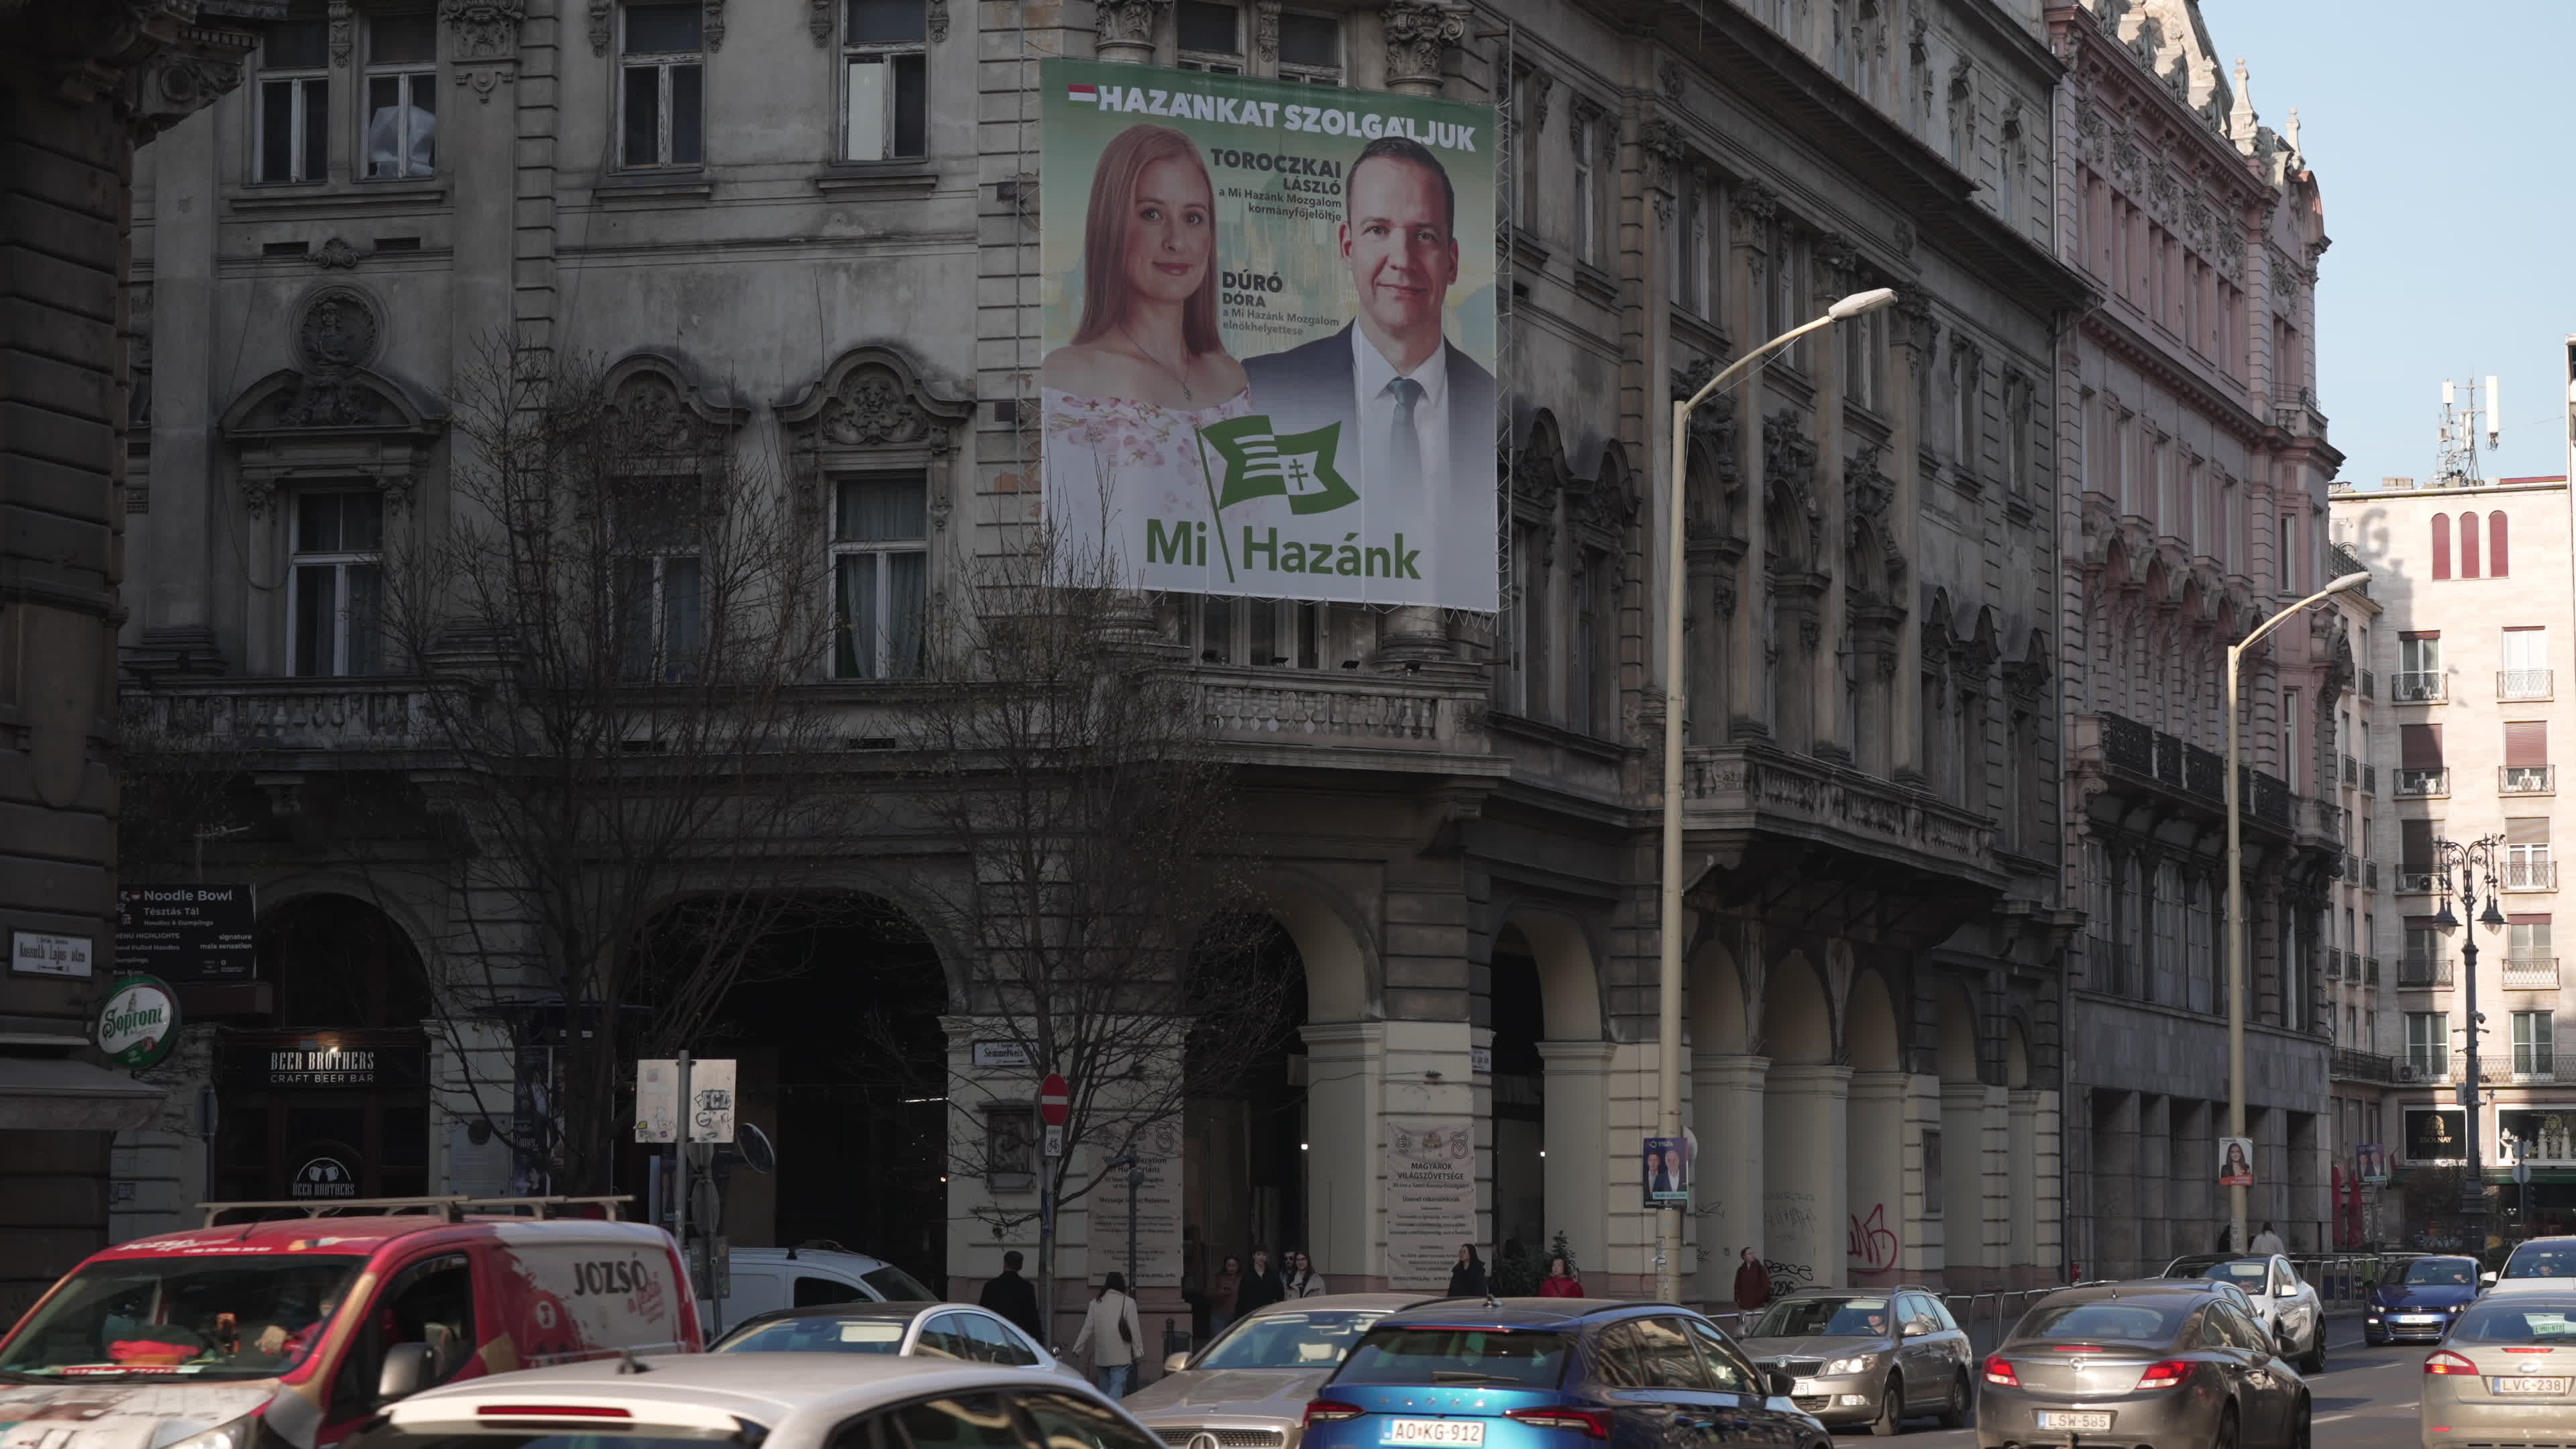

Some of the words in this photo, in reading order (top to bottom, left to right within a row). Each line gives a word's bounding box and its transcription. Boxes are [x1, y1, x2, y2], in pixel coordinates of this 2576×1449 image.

[1098, 85, 1279, 128] HAZÁNKAT
[1283, 104, 1477, 152] SZOLGÁLJUK
[1211, 148, 1341, 178] TOROCZKAI
[1283, 176, 1341, 195] LÁSZLÓ
[1228, 187, 1242, 198] Mi
[1244, 190, 1283, 203] Hazánk
[1287, 193, 1341, 208] Mozgalom
[1248, 203, 1341, 223] kormányfőjelöltje
[1222, 269, 1283, 292] DÚRÓ
[1223, 291, 1266, 307] DÓRA
[1232, 308, 1244, 317] Mi
[1247, 309, 1284, 321] Hazánk
[1287, 313, 1339, 327] Mozgalom
[1223, 321, 1303, 335] elnökhelyettese
[1147, 518, 1206, 566] Mi
[1243, 525, 1421, 580] Hazánk
[144, 890, 194, 902] Noodle
[198, 890, 233, 902] Bowl
[144, 906, 182, 916] Tésztás
[184, 906, 199, 916] Tál
[19, 942, 45, 959] Kossuth
[50, 945, 67, 965] Lajos
[103, 1004, 163, 1041] Soproni
[270, 1052, 303, 1070] BEER
[308, 1051, 374, 1070] BROTHERS
[984, 1047, 1024, 1057] Semmelweis
[270, 1074, 309, 1083] CRAFT
[315, 1074, 344, 1083] BEER
[350, 1074, 374, 1083] BAR
[1397, 1171, 1464, 1180] VILÁGSZÖVETSÉGE
[292, 1183, 312, 1197] BEER
[315, 1183, 354, 1197] BROTHERS
[574, 1250, 648, 1296] JOZSÓ
[2503, 1379, 2561, 1391] LVC-238
[2049, 1415, 2106, 1428] LSW-585
[1395, 1423, 1415, 1439] AO
[1424, 1424, 1480, 1442] KG-912
